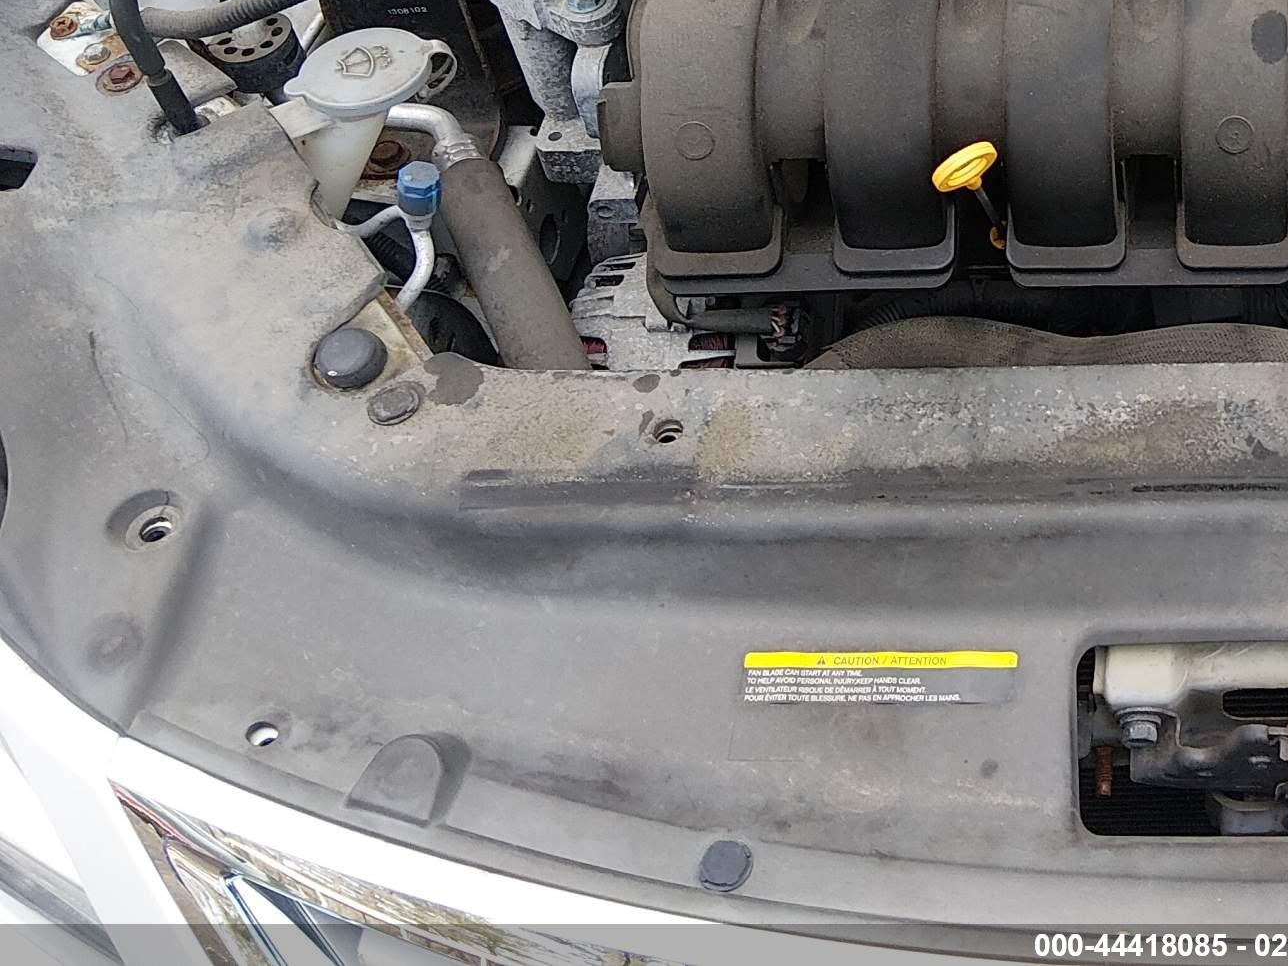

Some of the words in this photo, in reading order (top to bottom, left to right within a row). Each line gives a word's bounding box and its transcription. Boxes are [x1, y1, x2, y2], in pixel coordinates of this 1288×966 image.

[833, 656, 879, 665] CAUTION
[890, 656, 947, 665] ATTENTION
[745, 686, 754, 694] LE
[755, 686, 797, 694] VENTILATEUR
[798, 686, 823, 694] RISQUE
[824, 686, 834, 694] DE
[878, 686, 895, 694] TOUT
[744, 694, 764, 702] POUR
[788, 694, 810, 702] TOUTE
[847, 694, 858, 702] NE
[860, 694, 871, 702] PAS
[873, 694, 883, 702] EN
[883, 694, 924, 702] APPROCHER
[925, 694, 937, 702] LES
